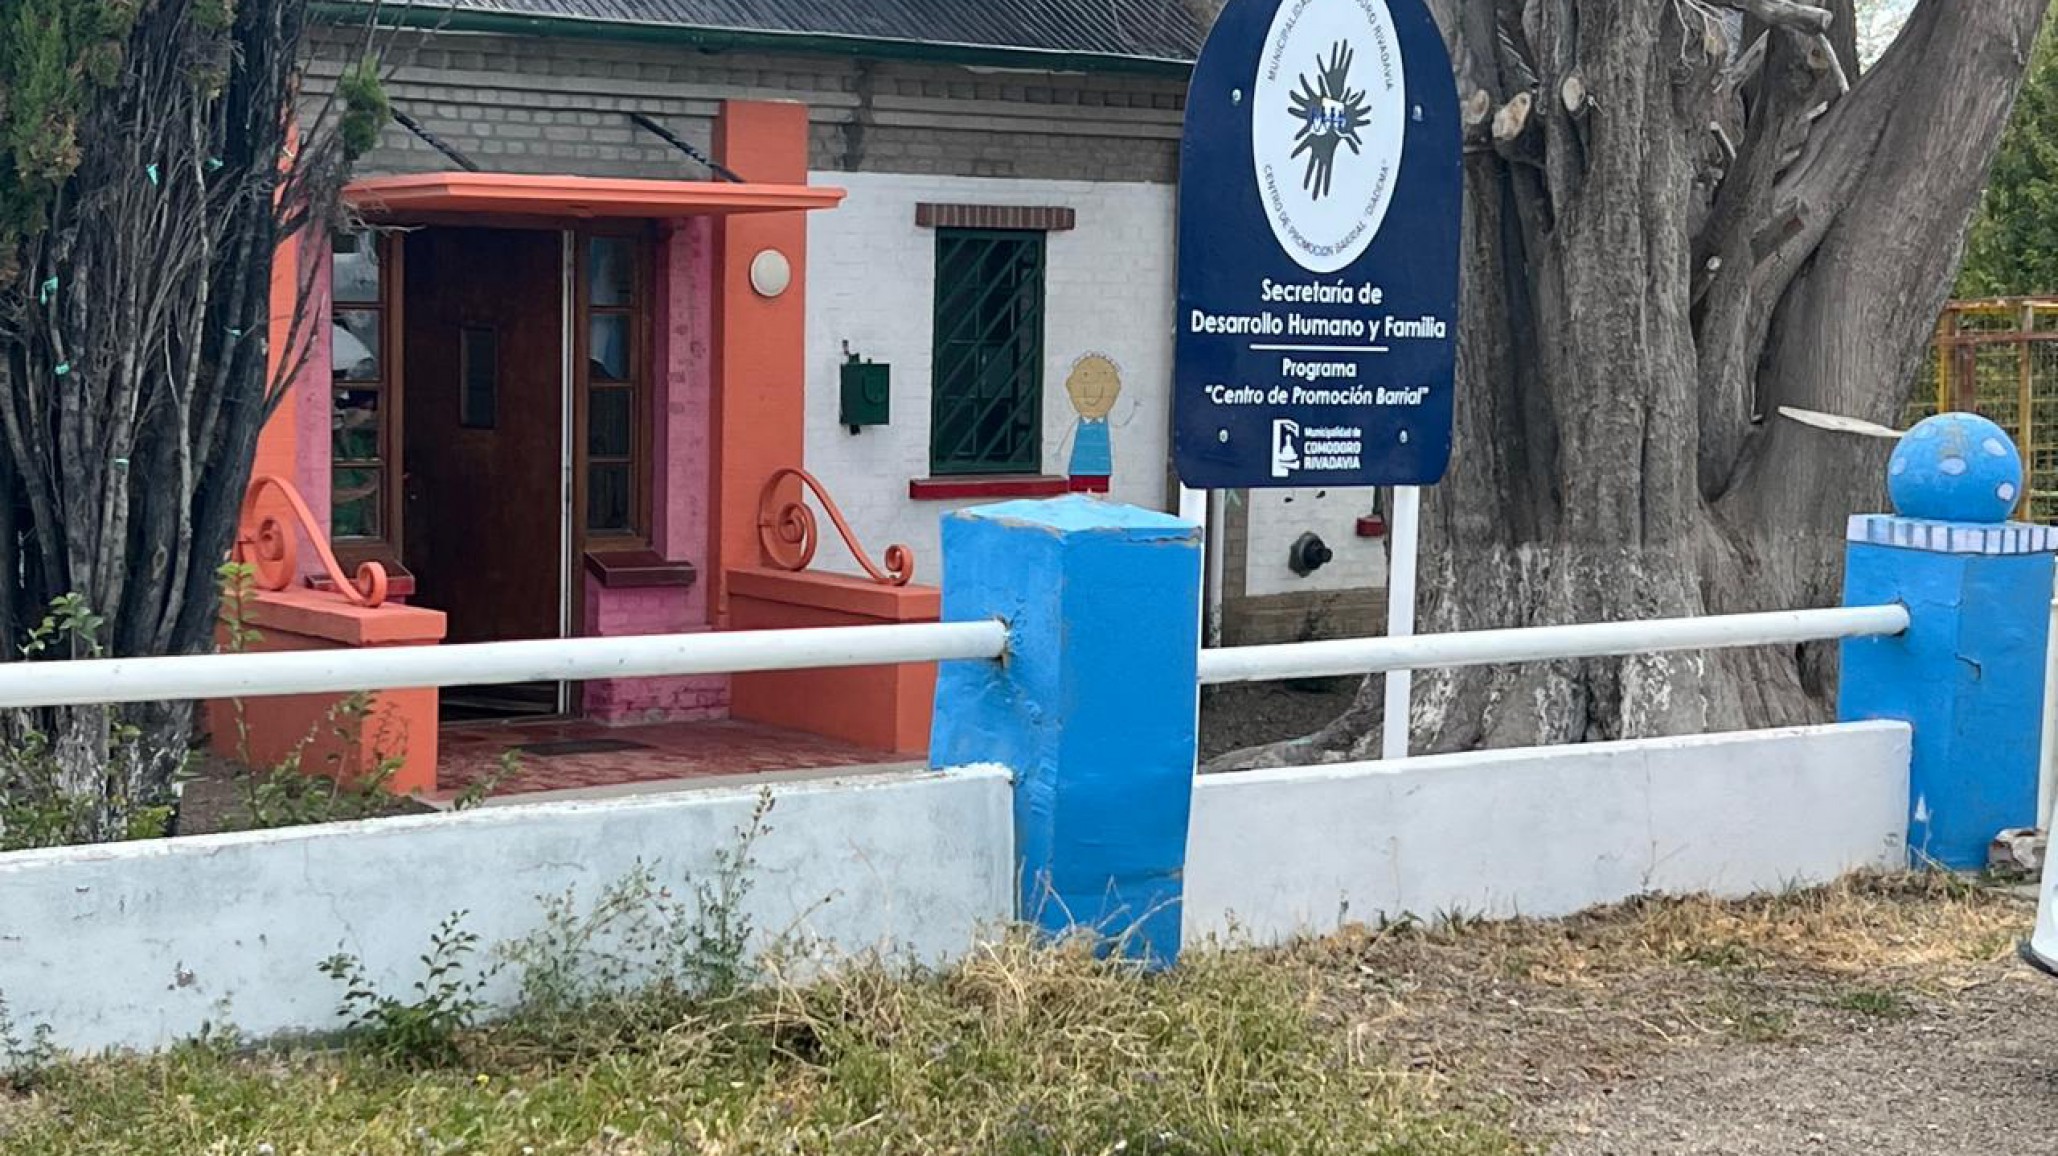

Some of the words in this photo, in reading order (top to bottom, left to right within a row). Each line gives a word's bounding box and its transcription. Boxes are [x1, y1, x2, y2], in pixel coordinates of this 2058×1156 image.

[1373, 24, 1394, 91] RIVADAVIA
[1264, 165, 1283, 212] CENTRO
[1278, 211, 1291, 228] DE
[1335, 220, 1366, 254] BARRIAL
[1261, 278, 1353, 303] Secretaría
[1358, 282, 1383, 304] de
[1191, 309, 1283, 333] Desarrollo
[1287, 313, 1364, 336] Humano
[1368, 320, 1380, 342] y
[1384, 315, 1446, 338] Familia
[1282, 357, 1357, 381] Programa
[1267, 385, 1289, 404] de
[1292, 385, 1373, 405] Promoción
[1304, 440, 1362, 454] COMODORO
[1304, 456, 1361, 470] RIVADAVIA
